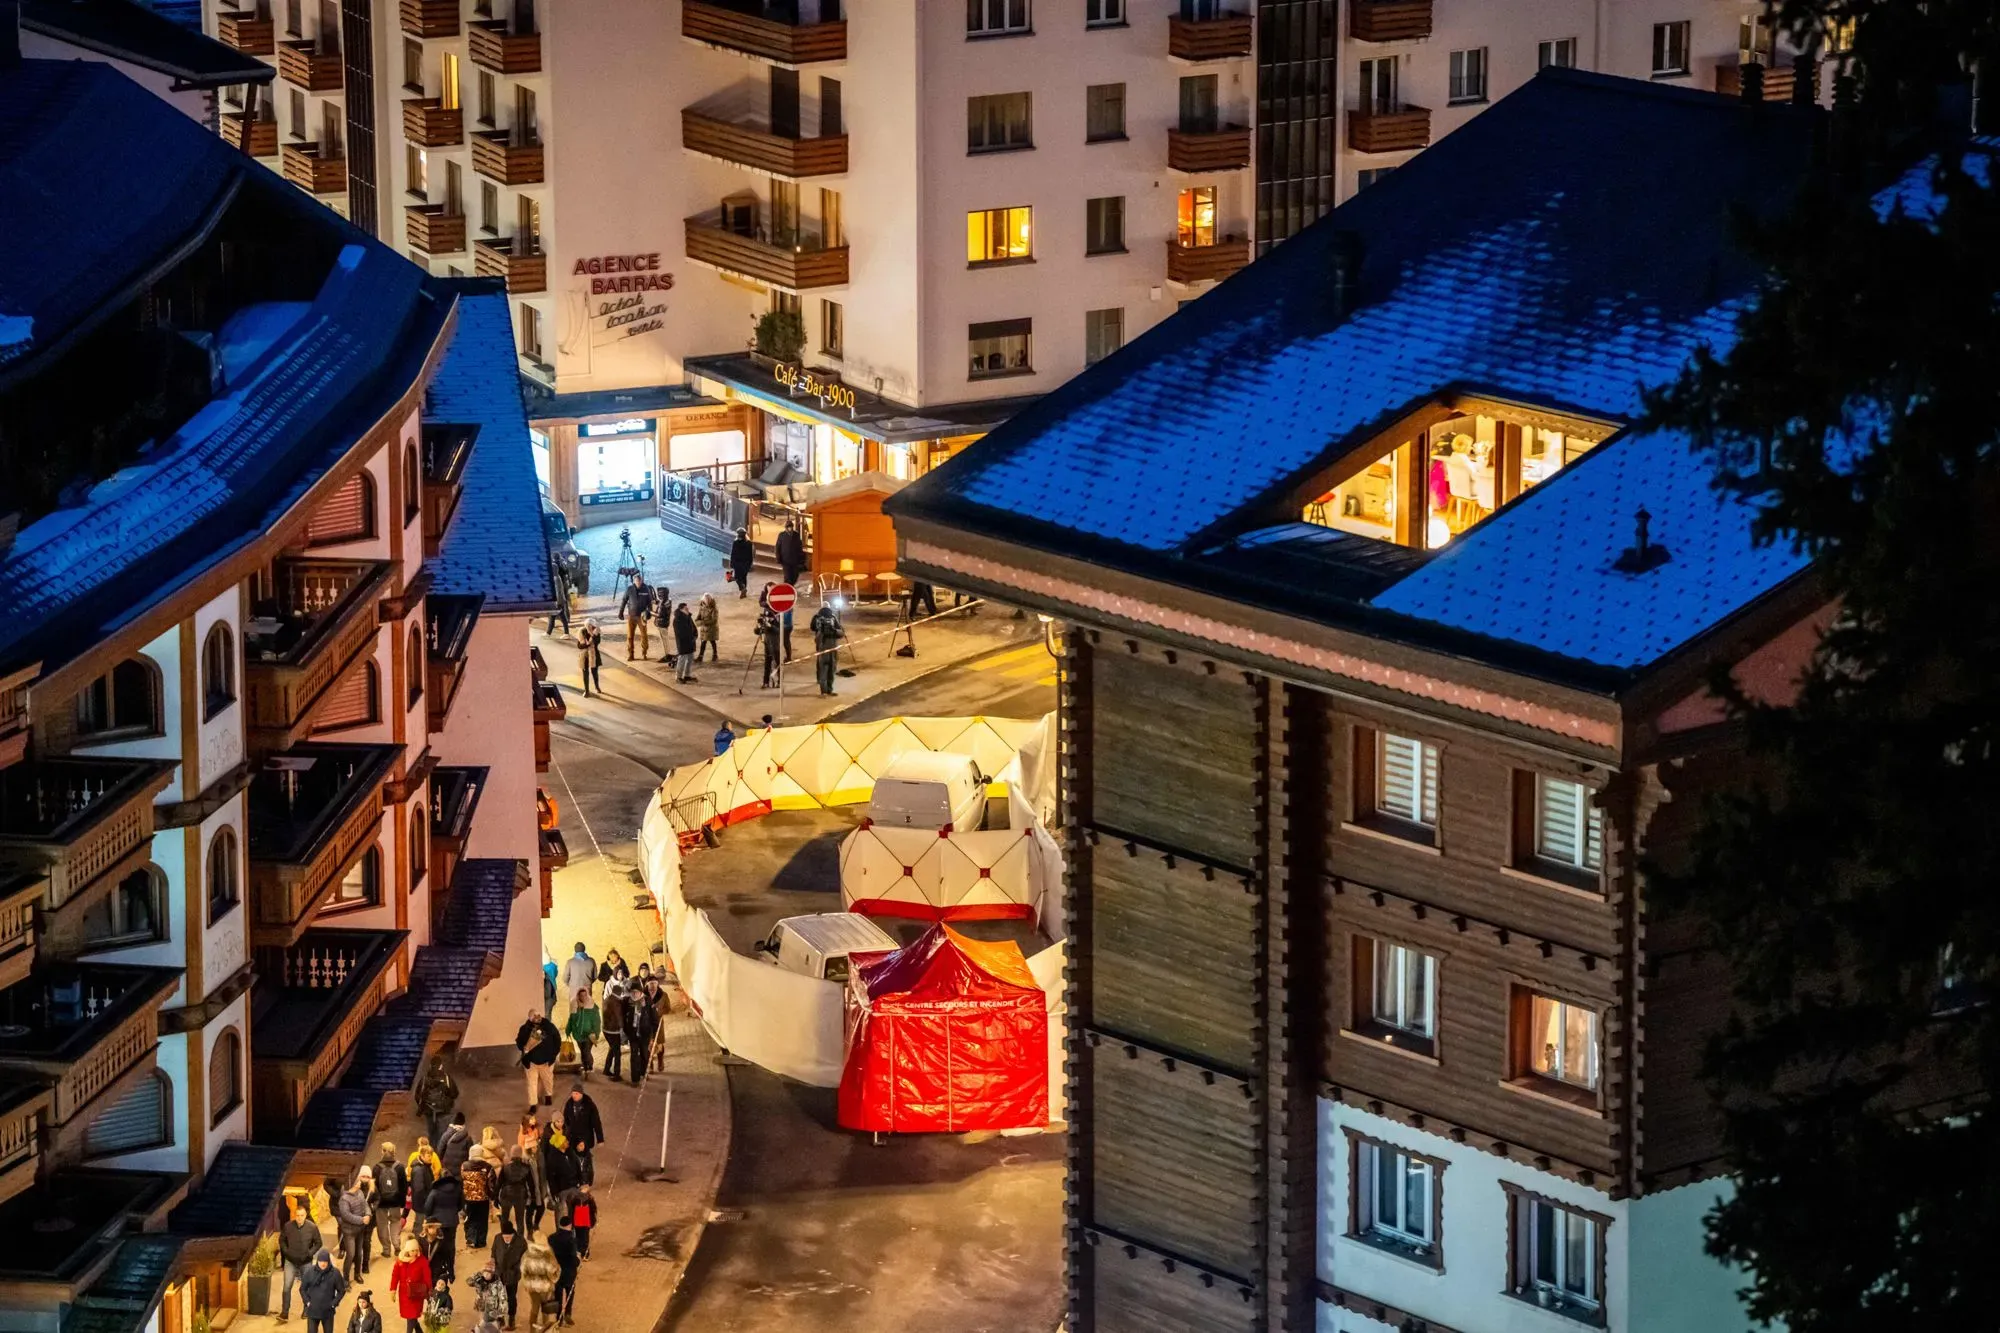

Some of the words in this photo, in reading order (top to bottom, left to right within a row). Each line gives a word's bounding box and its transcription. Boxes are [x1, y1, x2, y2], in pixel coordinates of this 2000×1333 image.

[573, 253, 661, 275] AGENCE
[591, 273, 675, 295] BARRAS
[600, 292, 644, 315] achat
[627, 319, 664, 336] vente
[774, 363, 798, 388] Café
[806, 375, 824, 397] Bar
[827, 383, 855, 409] 1900
[979, 1000, 1015, 1008] INCENDIE
